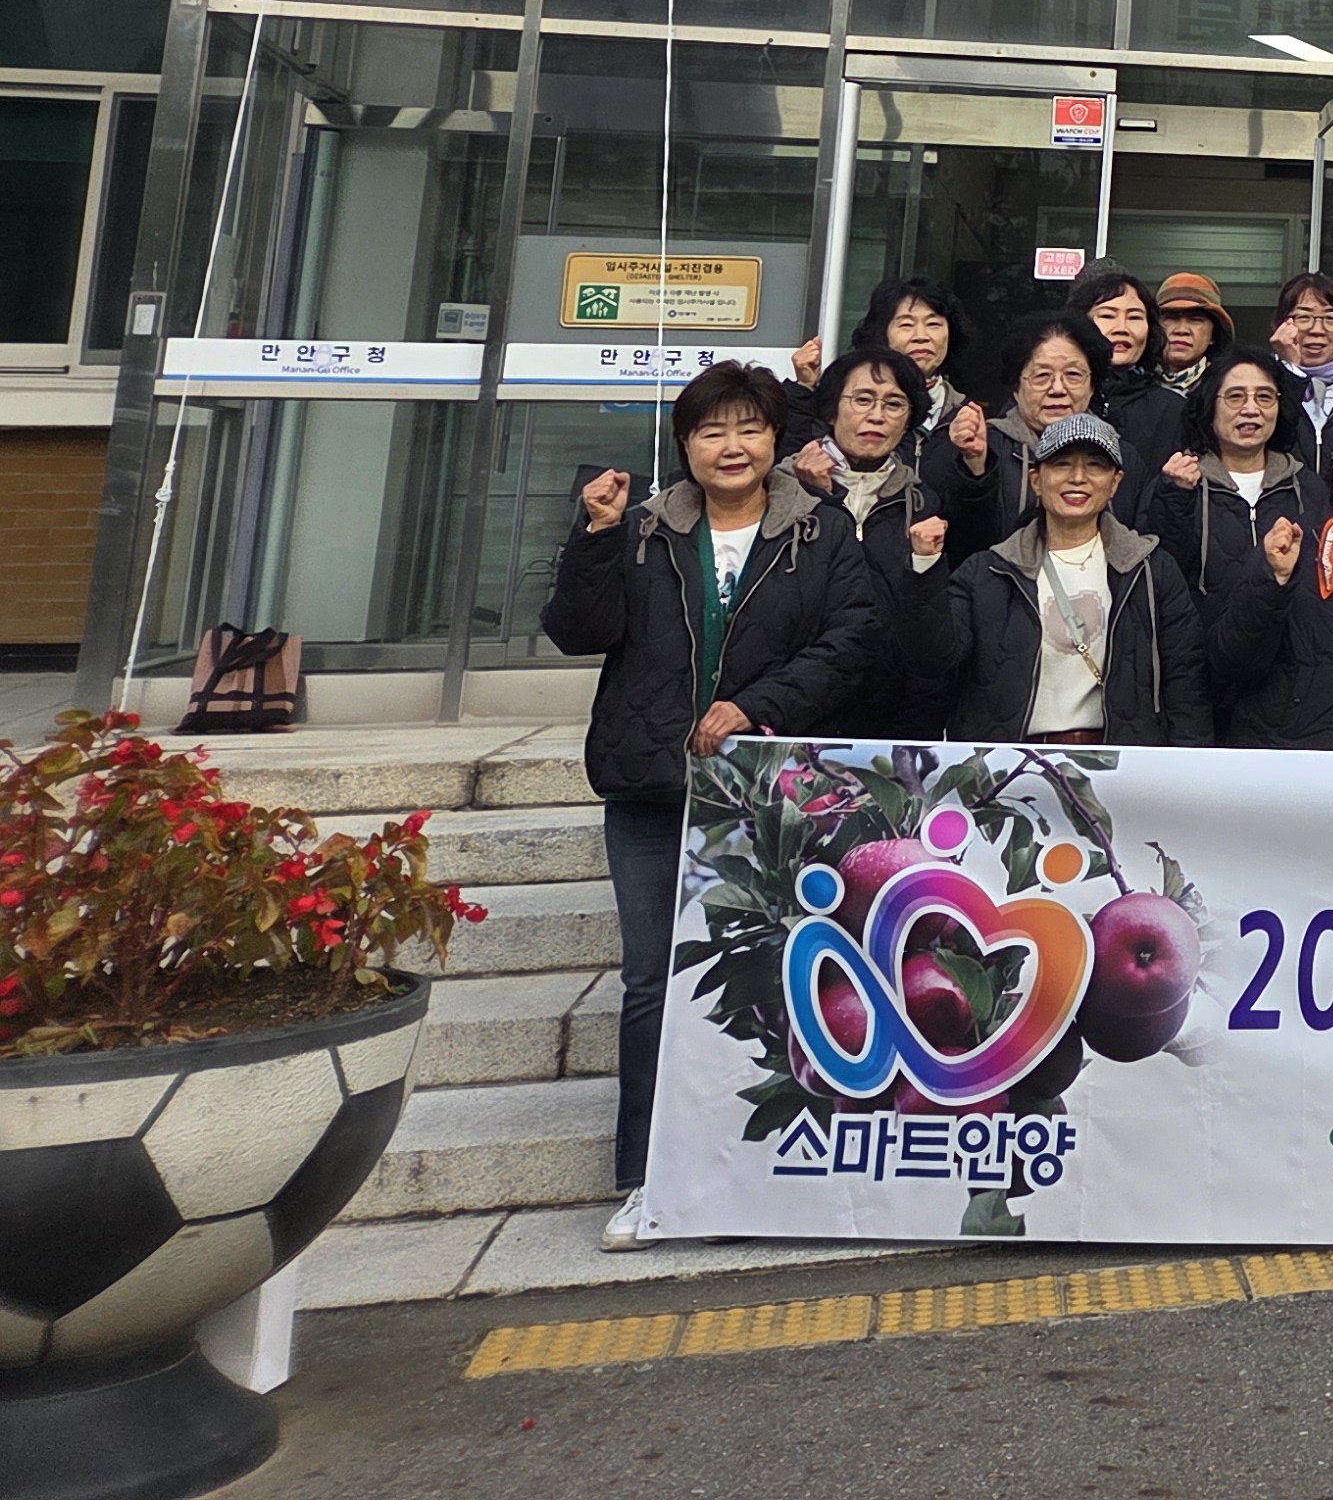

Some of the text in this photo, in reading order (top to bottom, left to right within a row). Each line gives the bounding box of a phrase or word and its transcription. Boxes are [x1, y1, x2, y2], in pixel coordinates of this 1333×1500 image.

[1041, 265, 1076, 275] FIXED
[261, 344, 386, 364] 만안구청
[600, 349, 715, 367] 만안구청
[281, 365, 361, 375] Manan-Gu Office
[666, 369, 692, 378] Office
[773, 1117, 1076, 1187] 스마트안양
